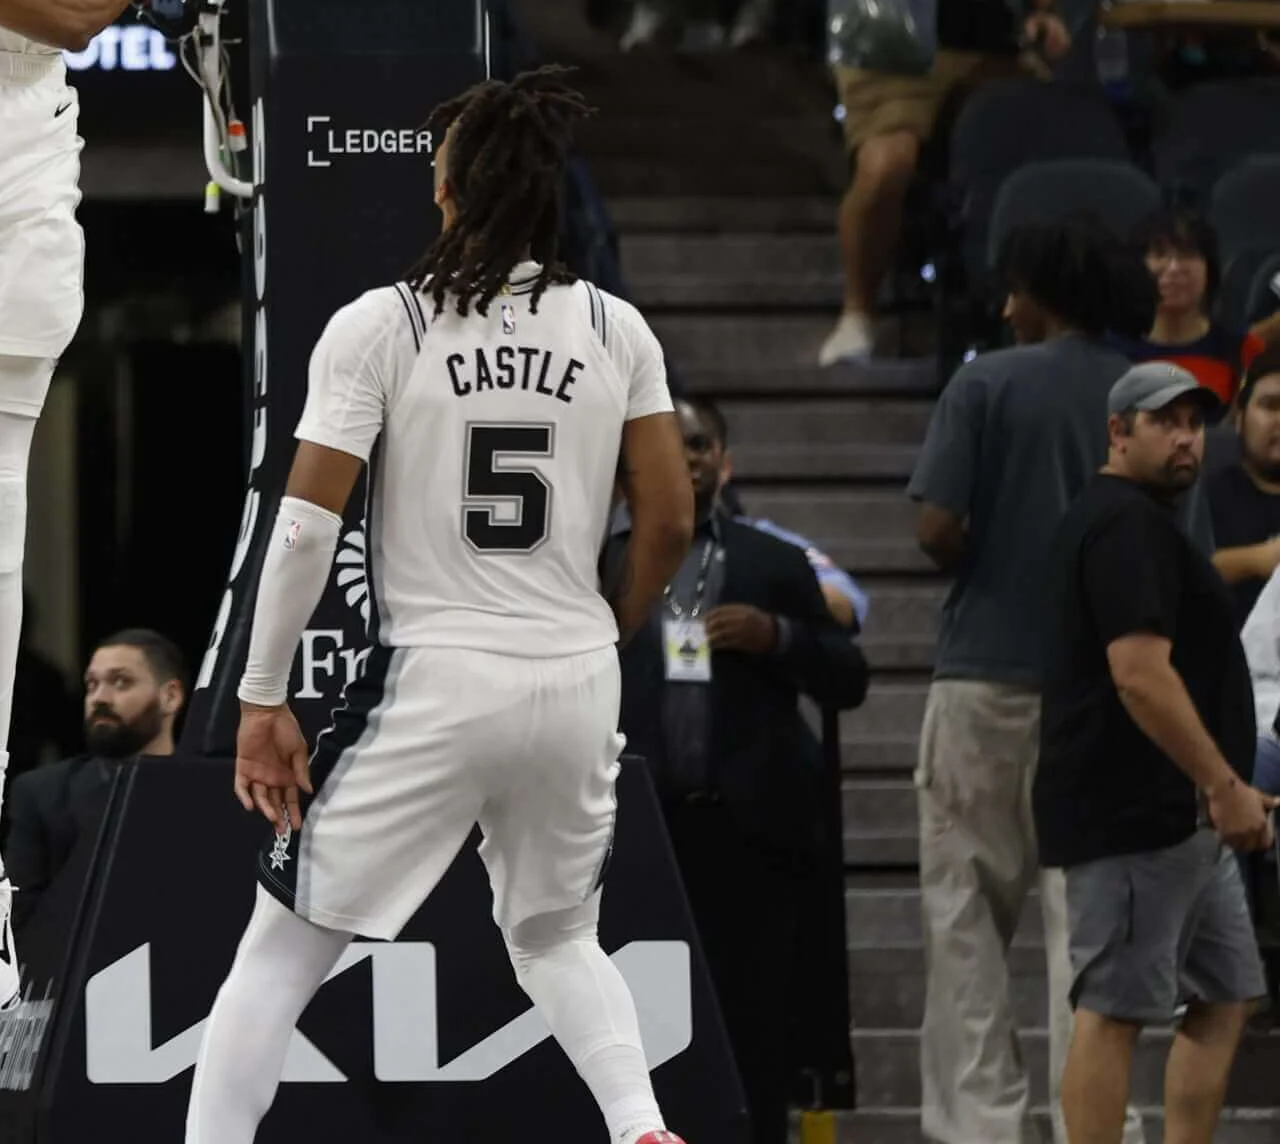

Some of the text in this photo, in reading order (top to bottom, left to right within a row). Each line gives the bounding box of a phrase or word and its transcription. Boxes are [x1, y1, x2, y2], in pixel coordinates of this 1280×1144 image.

[64, 23, 177, 71] OTEL
[328, 129, 433, 153] LEDGER
[446, 345, 585, 404] CASTLE
[460, 420, 556, 556] 5
